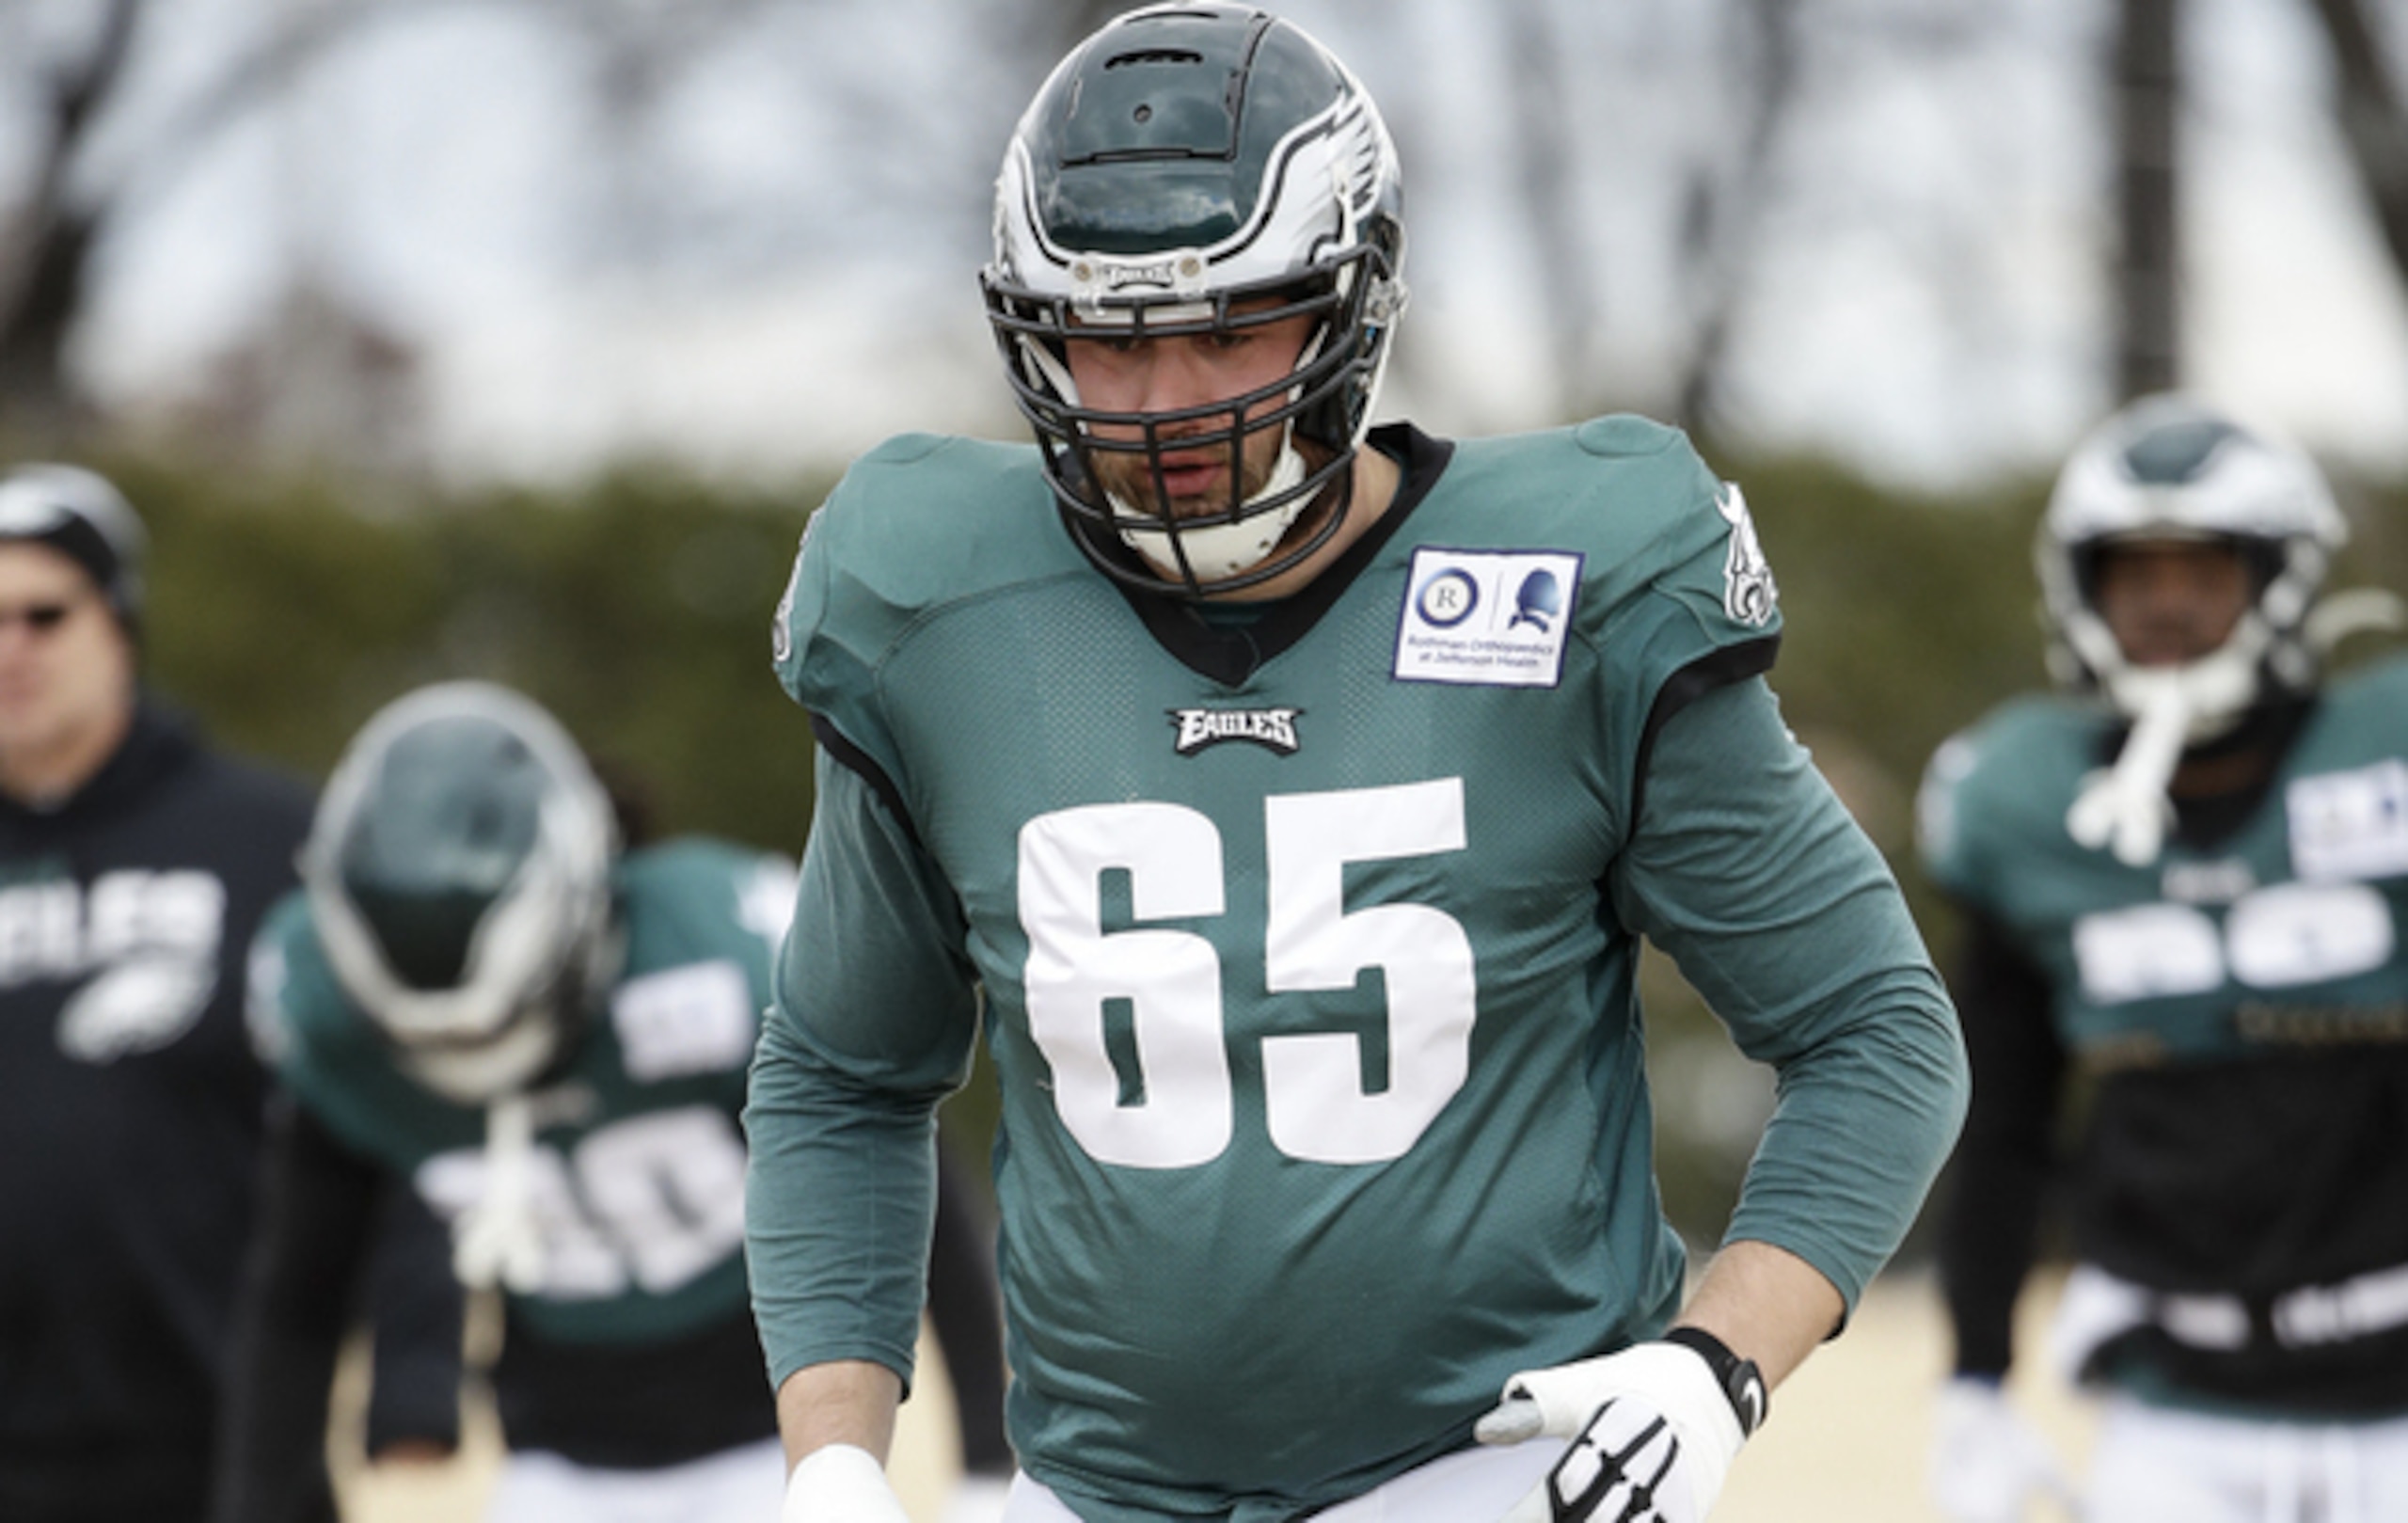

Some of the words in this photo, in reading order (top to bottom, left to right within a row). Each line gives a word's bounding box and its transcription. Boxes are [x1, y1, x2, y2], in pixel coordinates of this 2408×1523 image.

[1435, 587, 1457, 608] R
[1172, 708, 1301, 755] EAGLES
[1017, 776, 1477, 1169] 65
